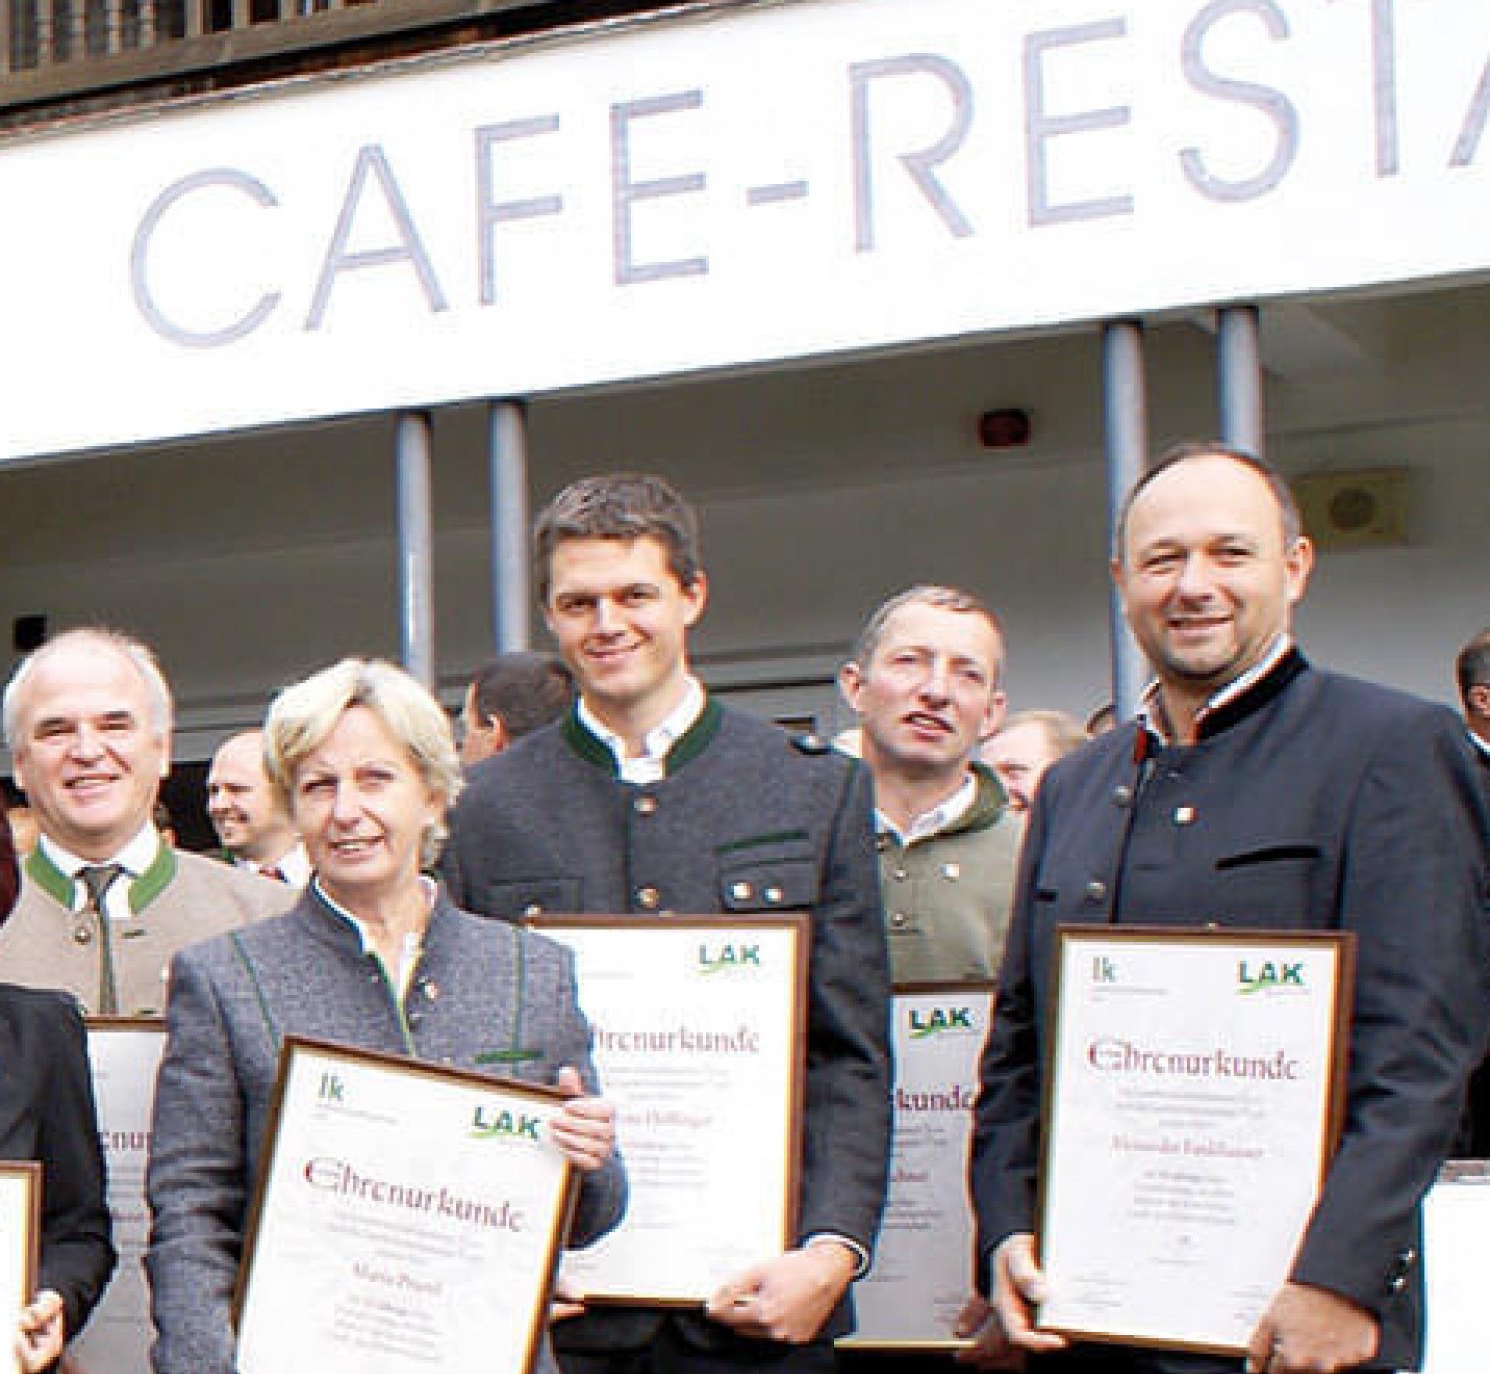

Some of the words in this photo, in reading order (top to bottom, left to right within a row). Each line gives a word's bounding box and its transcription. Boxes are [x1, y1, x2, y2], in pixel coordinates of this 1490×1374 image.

[698, 943, 761, 966] LAK
[1237, 959, 1305, 985] LAK
[908, 1006, 973, 1031] LAK
[1087, 1036, 1300, 1081] Ehrenurkunde
[472, 1105, 542, 1139] LAK
[303, 1156, 524, 1234] Ehrenurkunde
